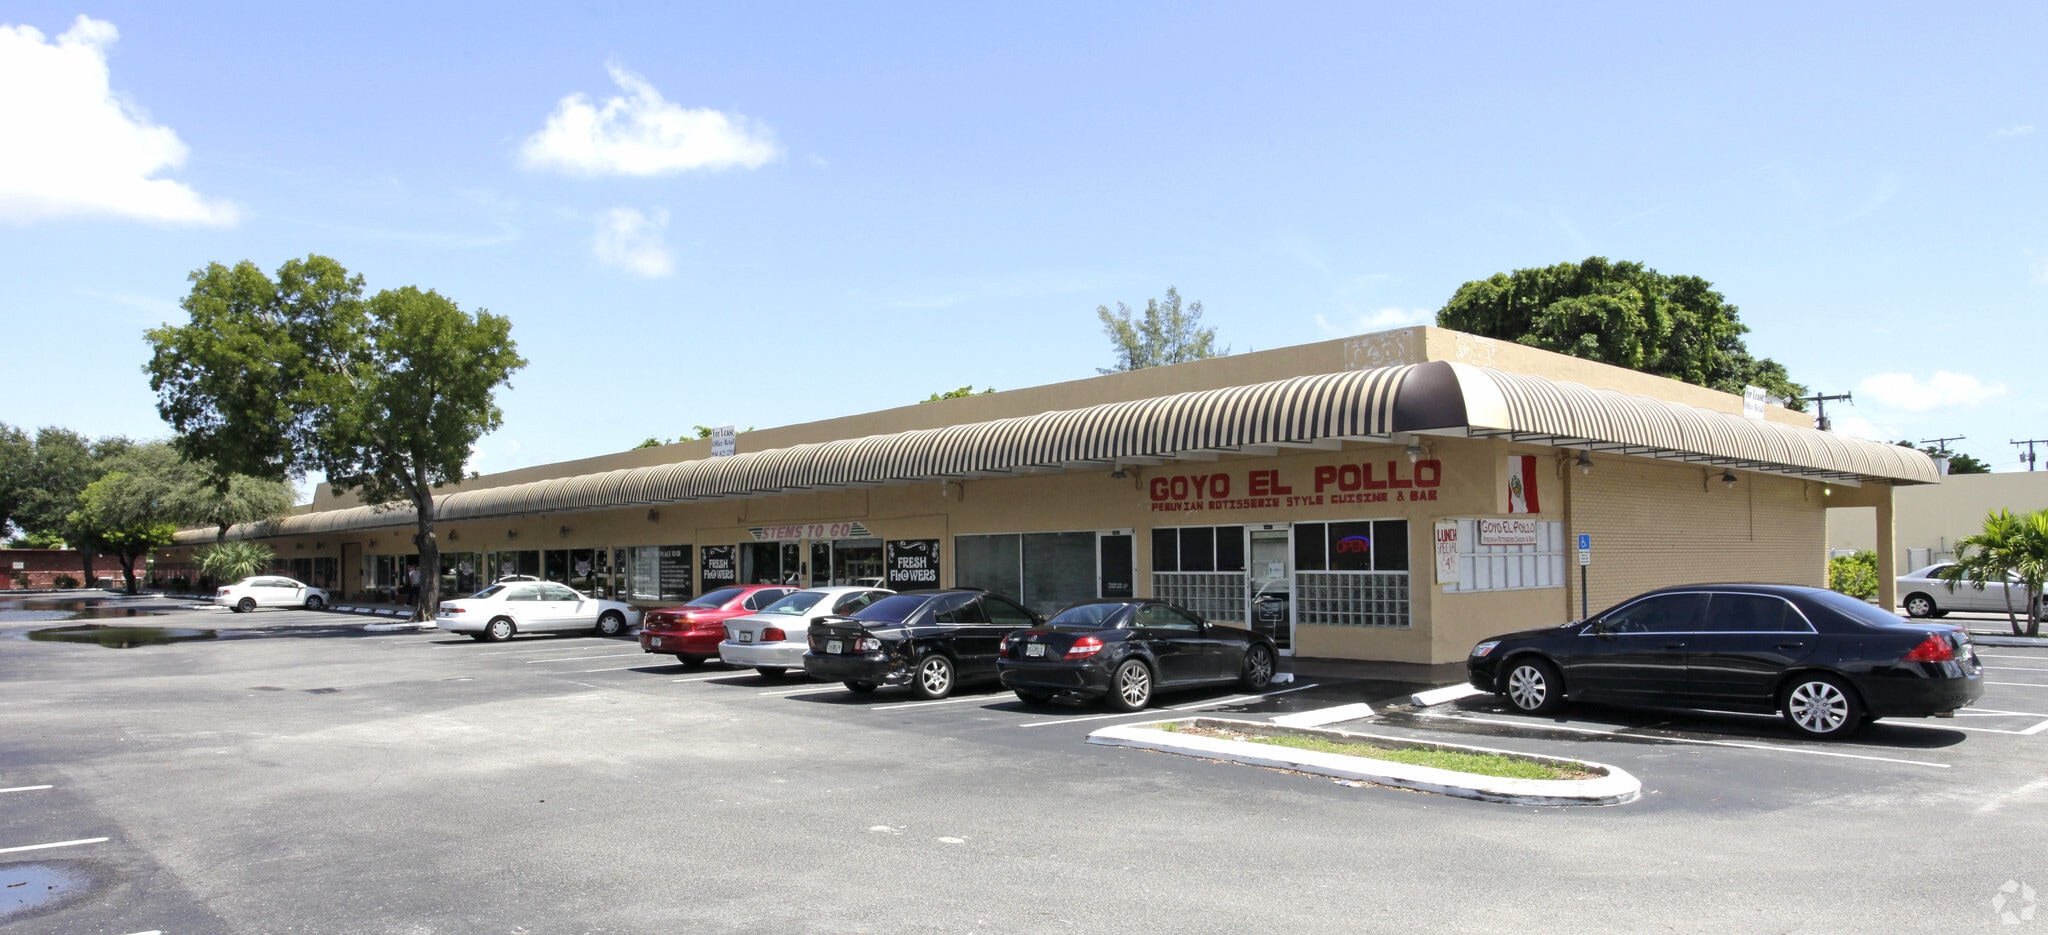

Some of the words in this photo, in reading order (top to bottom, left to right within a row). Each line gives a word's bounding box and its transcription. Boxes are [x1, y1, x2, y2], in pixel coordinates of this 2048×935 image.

[712, 428, 720, 438] For
[720, 427, 734, 437] Lease
[1150, 473, 1230, 501] GOYO
[1249, 469, 1292, 497] EL
[1314, 459, 1441, 493] POLLO
[1152, 501, 1203, 512] PERUVIAN
[1209, 498, 1280, 510] ROTISSERIE
[1286, 495, 1324, 507] STYLE
[1331, 492, 1387, 504] CUISINE
[1397, 491, 1405, 502] &
[1410, 490, 1437, 502] BAR
[762, 526, 802, 540] STEMS
[807, 525, 824, 538] TO
[830, 523, 851, 537] GO
[1481, 520, 1502, 533] GOYO
[1503, 521, 1513, 533] EL
[1513, 521, 1535, 533] POLLO
[1437, 528, 1457, 542] LUNCH
[1336, 540, 1368, 553] OPEN
[1437, 542, 1458, 554] SPECIAL
[708, 559, 728, 569] FRESH
[897, 556, 927, 568] FRESH
[703, 569, 734, 579] FLOWERS
[890, 569, 936, 582] FLOWERS
